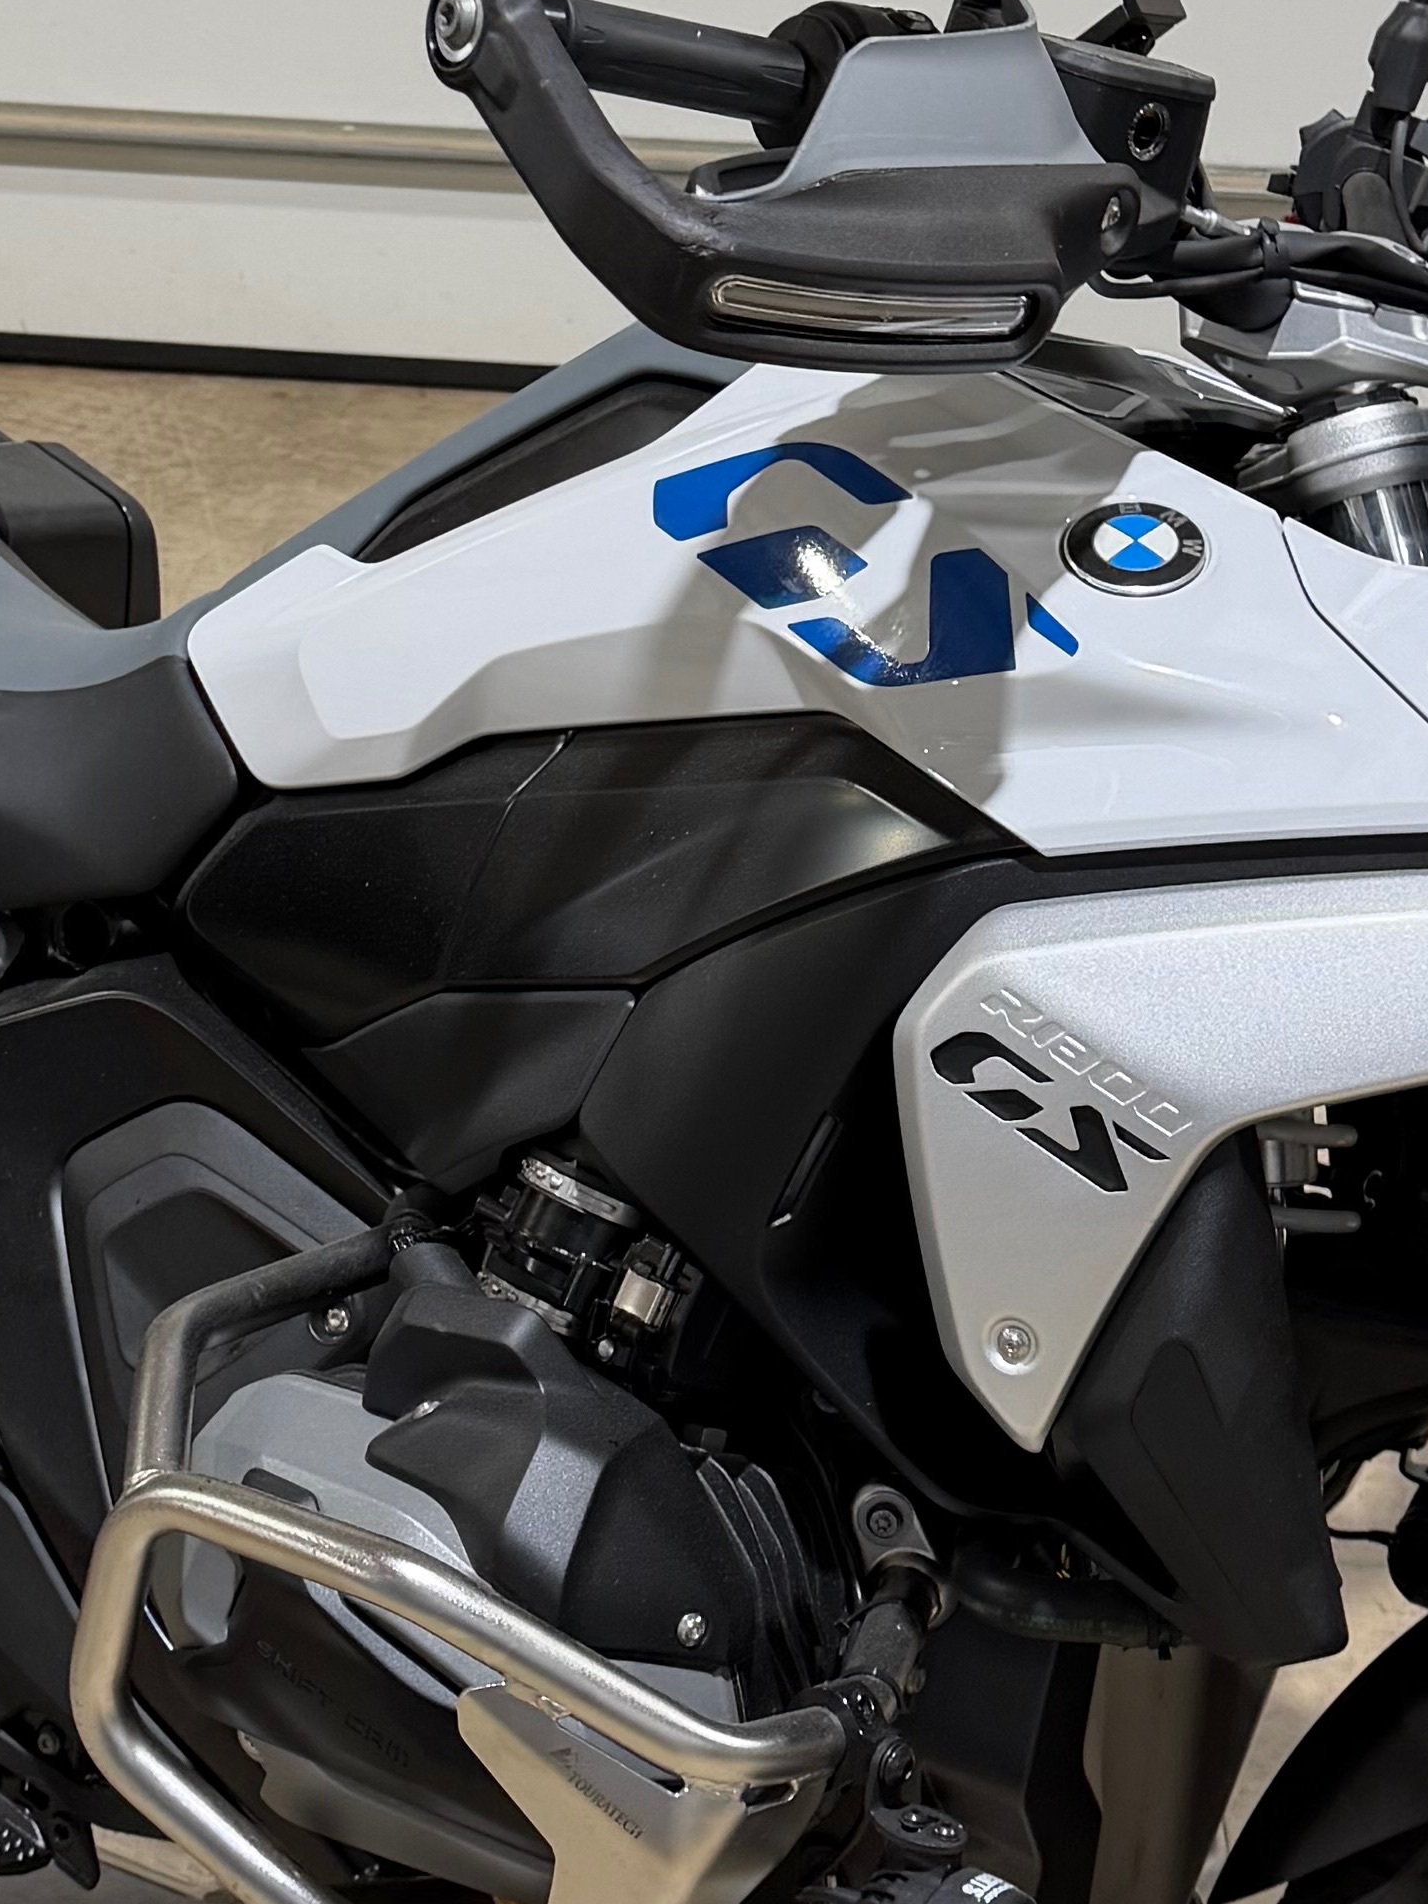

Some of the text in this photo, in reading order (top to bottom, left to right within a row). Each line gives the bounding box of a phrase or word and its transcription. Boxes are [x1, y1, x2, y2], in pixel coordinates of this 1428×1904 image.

[1118, 503, 1203, 557] BMW
[930, 1031, 1172, 1193] GS
[567, 1771, 644, 1839] TOURATECH
